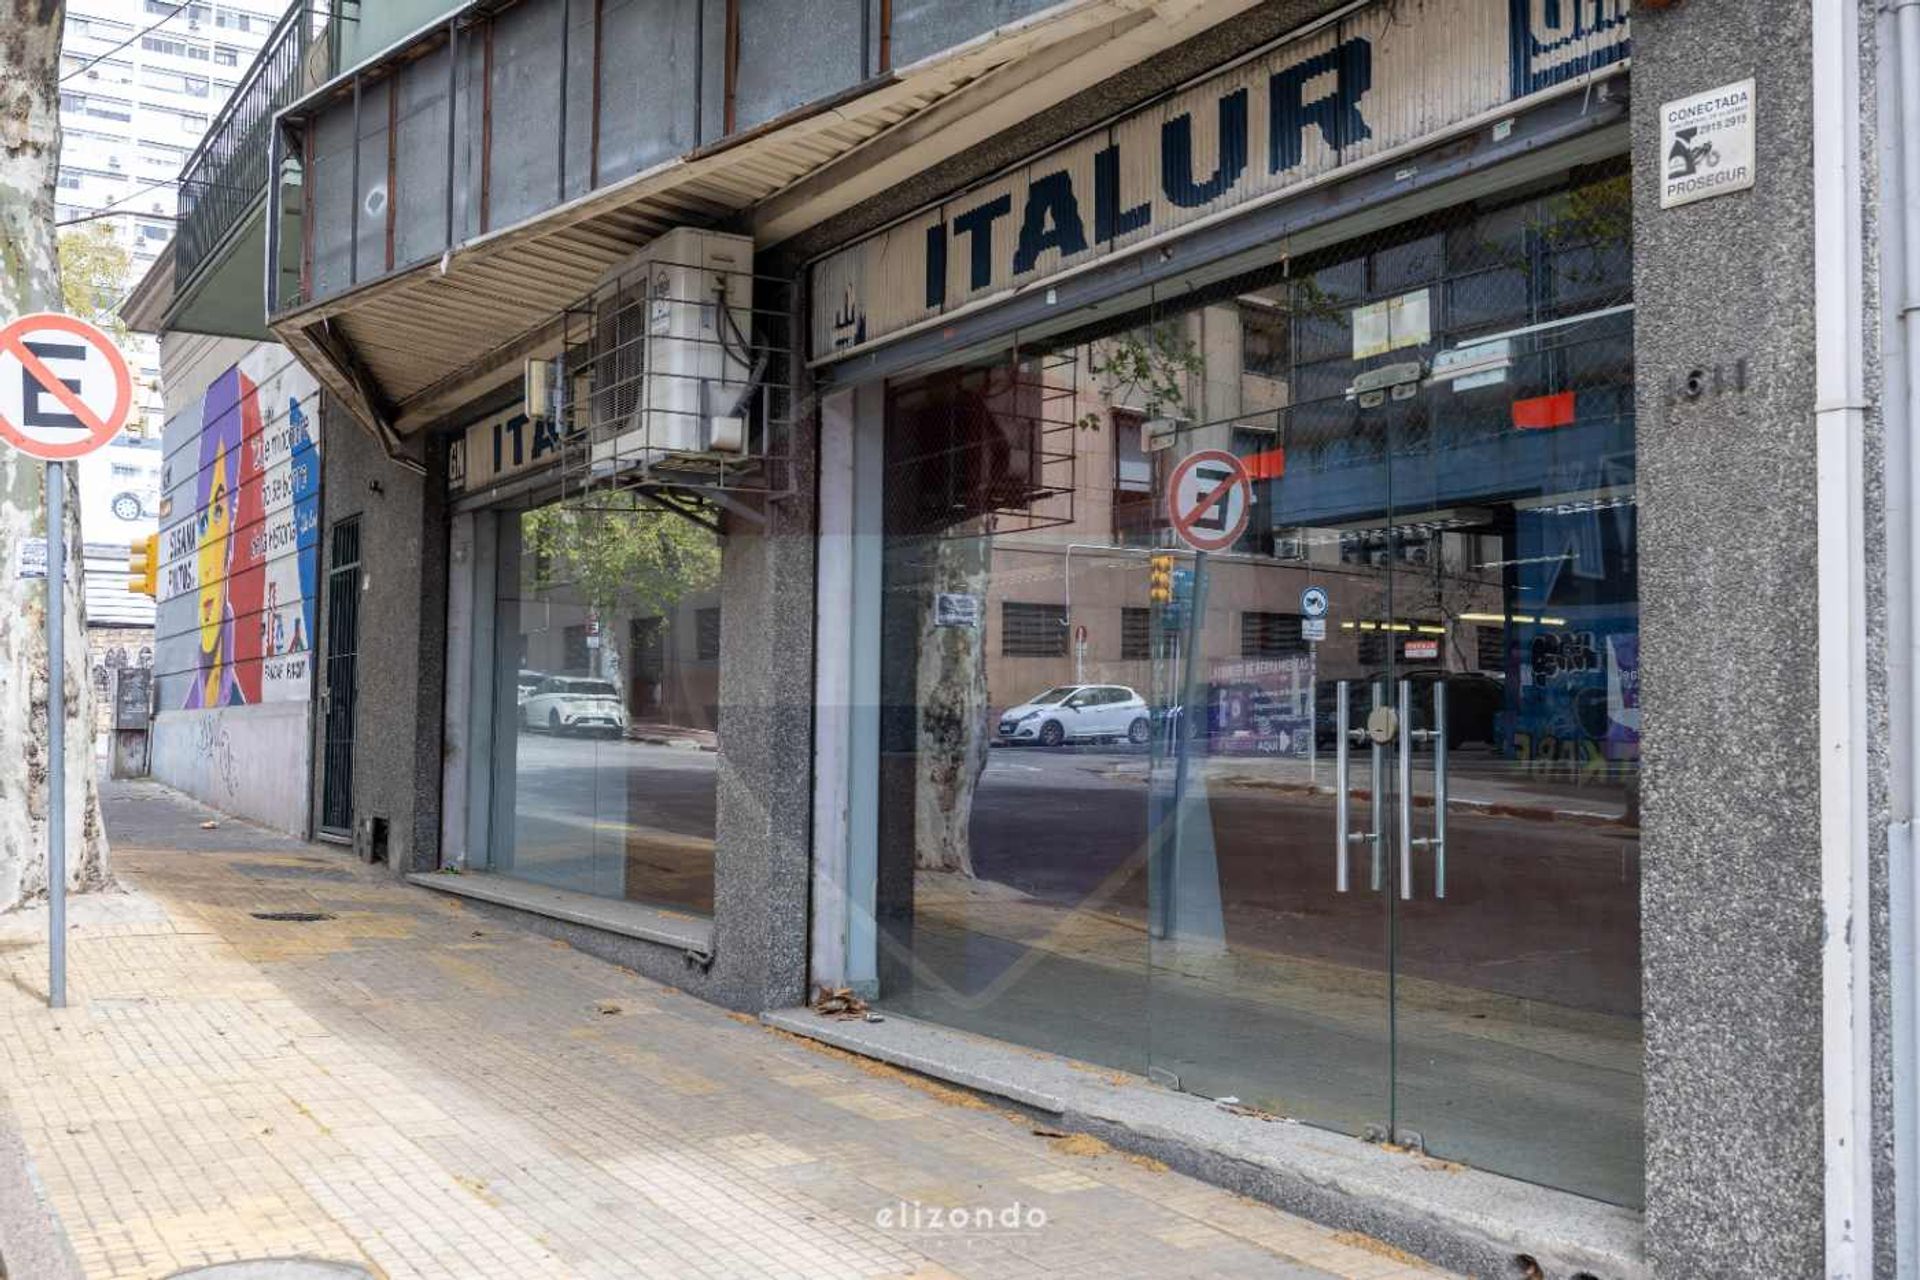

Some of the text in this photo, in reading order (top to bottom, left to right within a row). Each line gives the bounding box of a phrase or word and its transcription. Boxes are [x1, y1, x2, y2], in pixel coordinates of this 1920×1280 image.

[1668, 91, 1748, 123] CONECTADA
[927, 37, 1372, 309] ITALUR
[1667, 166, 1747, 197] PROSEGUR
